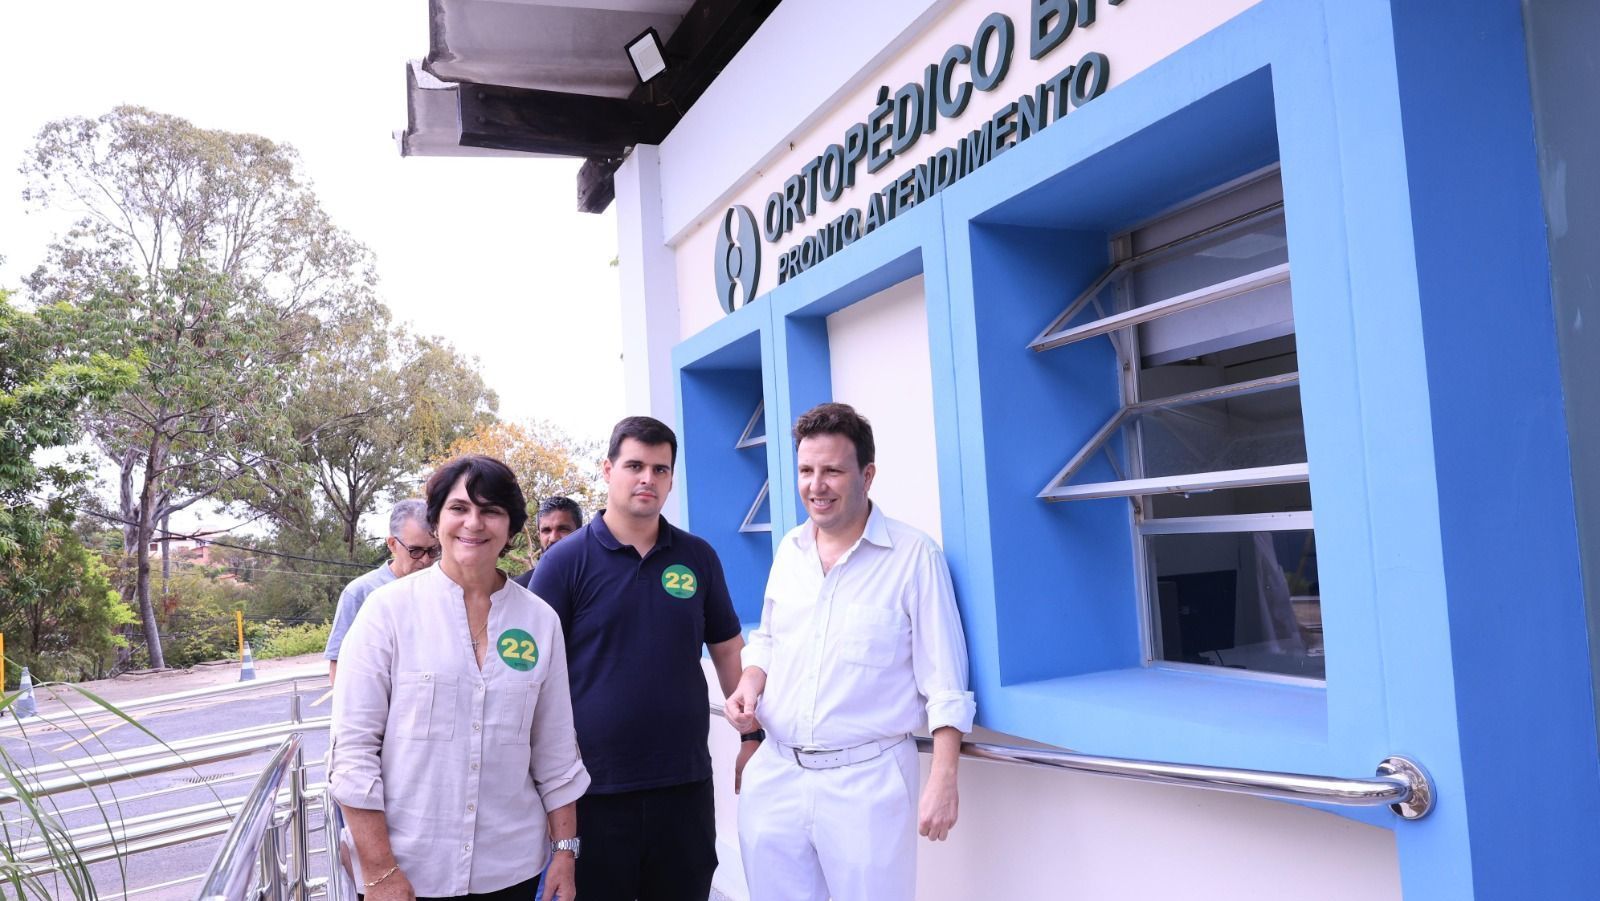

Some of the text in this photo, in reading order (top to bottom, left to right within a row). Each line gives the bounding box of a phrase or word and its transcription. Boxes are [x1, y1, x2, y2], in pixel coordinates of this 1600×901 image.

[764, 12, 1015, 243] ORTOPÉDICO
[778, 52, 1110, 286] PRONTO ATENDIMENTO
[665, 572, 694, 591] 22
[501, 638, 536, 662] 22
